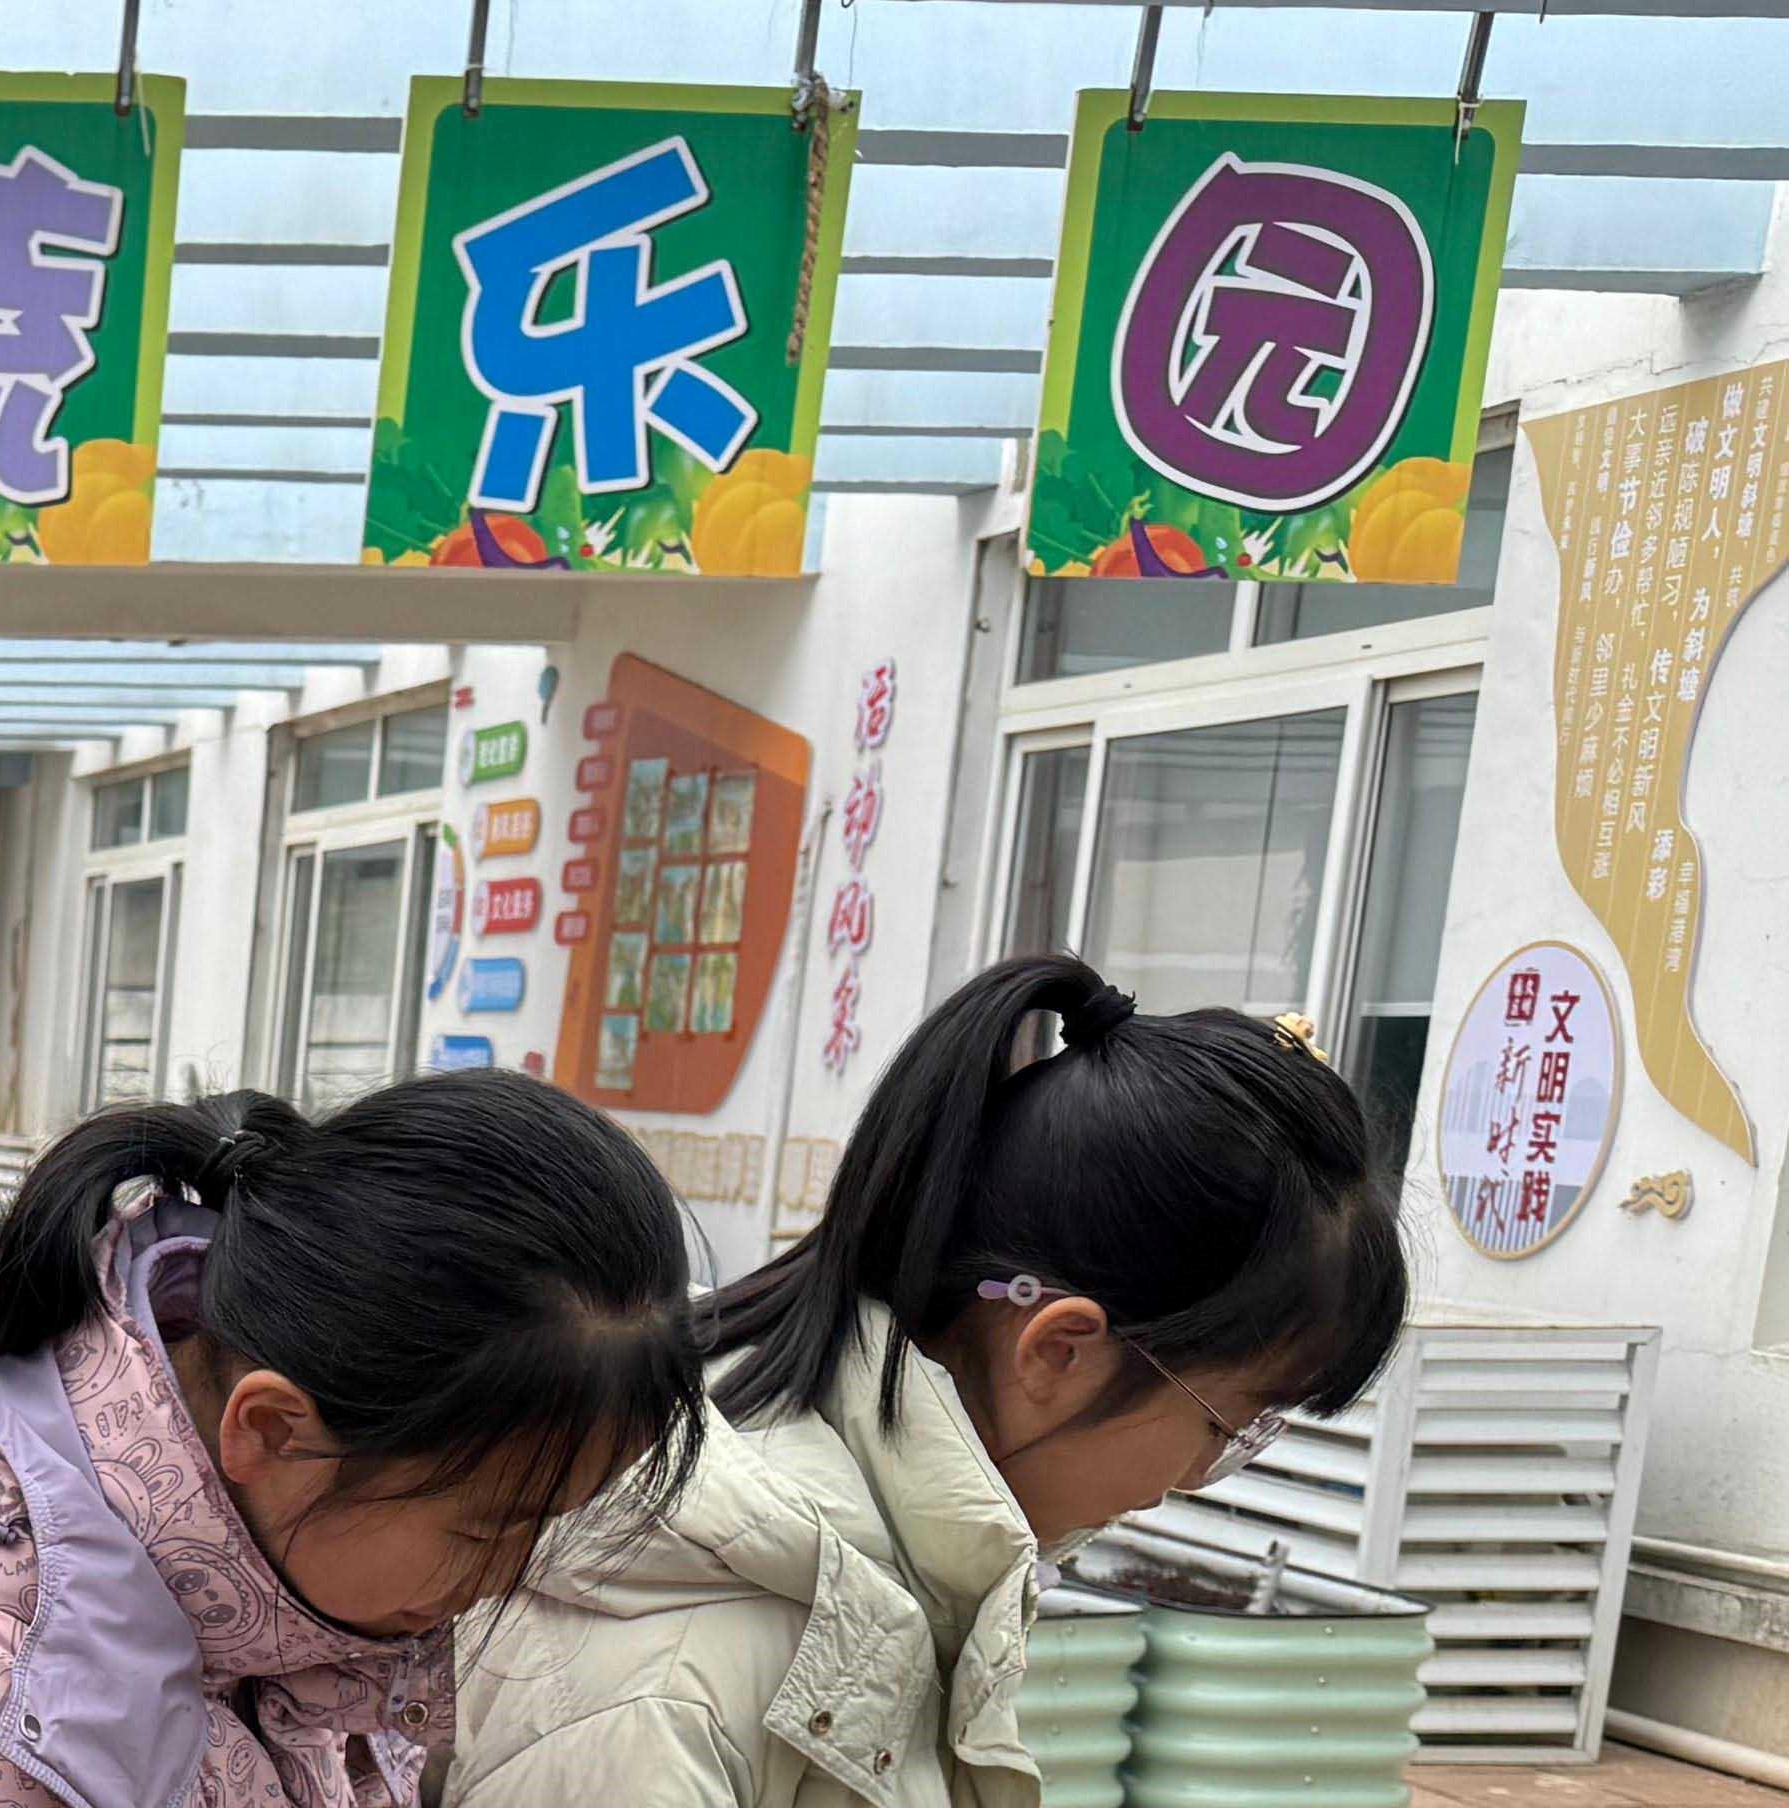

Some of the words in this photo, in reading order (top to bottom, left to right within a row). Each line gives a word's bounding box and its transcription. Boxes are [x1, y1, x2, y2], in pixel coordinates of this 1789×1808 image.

[454, 135, 755, 513] 乐
[1110, 151, 1435, 513] 园
[1517, 989, 1581, 1223] 文明实践
